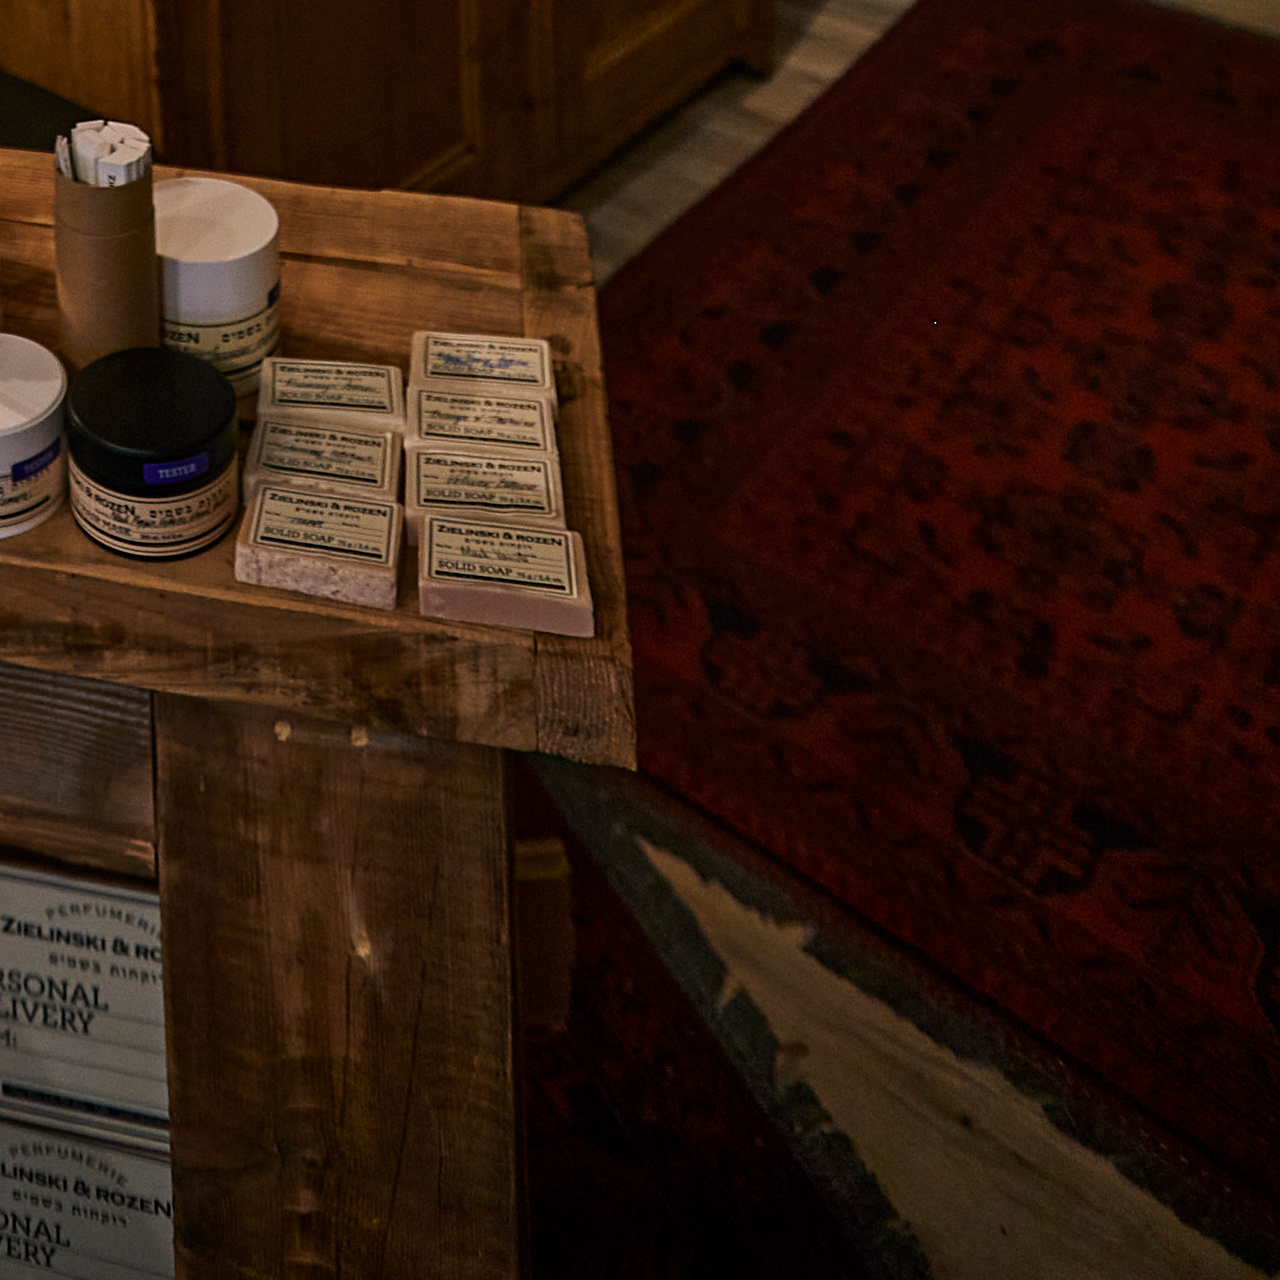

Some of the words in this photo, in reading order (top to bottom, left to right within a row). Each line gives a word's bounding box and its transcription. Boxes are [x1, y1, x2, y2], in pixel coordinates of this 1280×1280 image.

[158, 463, 197, 480] TESTER
[425, 457, 482, 468] ZIELINSKI
[486, 462, 494, 470] &
[498, 464, 542, 473] ROZEN
[94, 494, 136, 517] ROZEN
[269, 493, 328, 508] ZIELINSKI
[331, 502, 340, 510] &
[343, 505, 388, 517] ROZEN
[264, 526, 300, 539] SOLID
[303, 531, 335, 544] SOAP
[437, 525, 500, 539] ZIELINSKI
[503, 531, 513, 540] &
[516, 534, 562, 546] ROZEN
[437, 559, 476, 572] SOLID
[479, 564, 513, 576] SOAP
[0, 914, 107, 952] ZIELINSKI
[112, 937, 130, 957] &
[8, 1140, 130, 1188] PERFUMERIE
[73, 1178, 92, 1199] &
[96, 1186, 172, 1219] ROZEN
